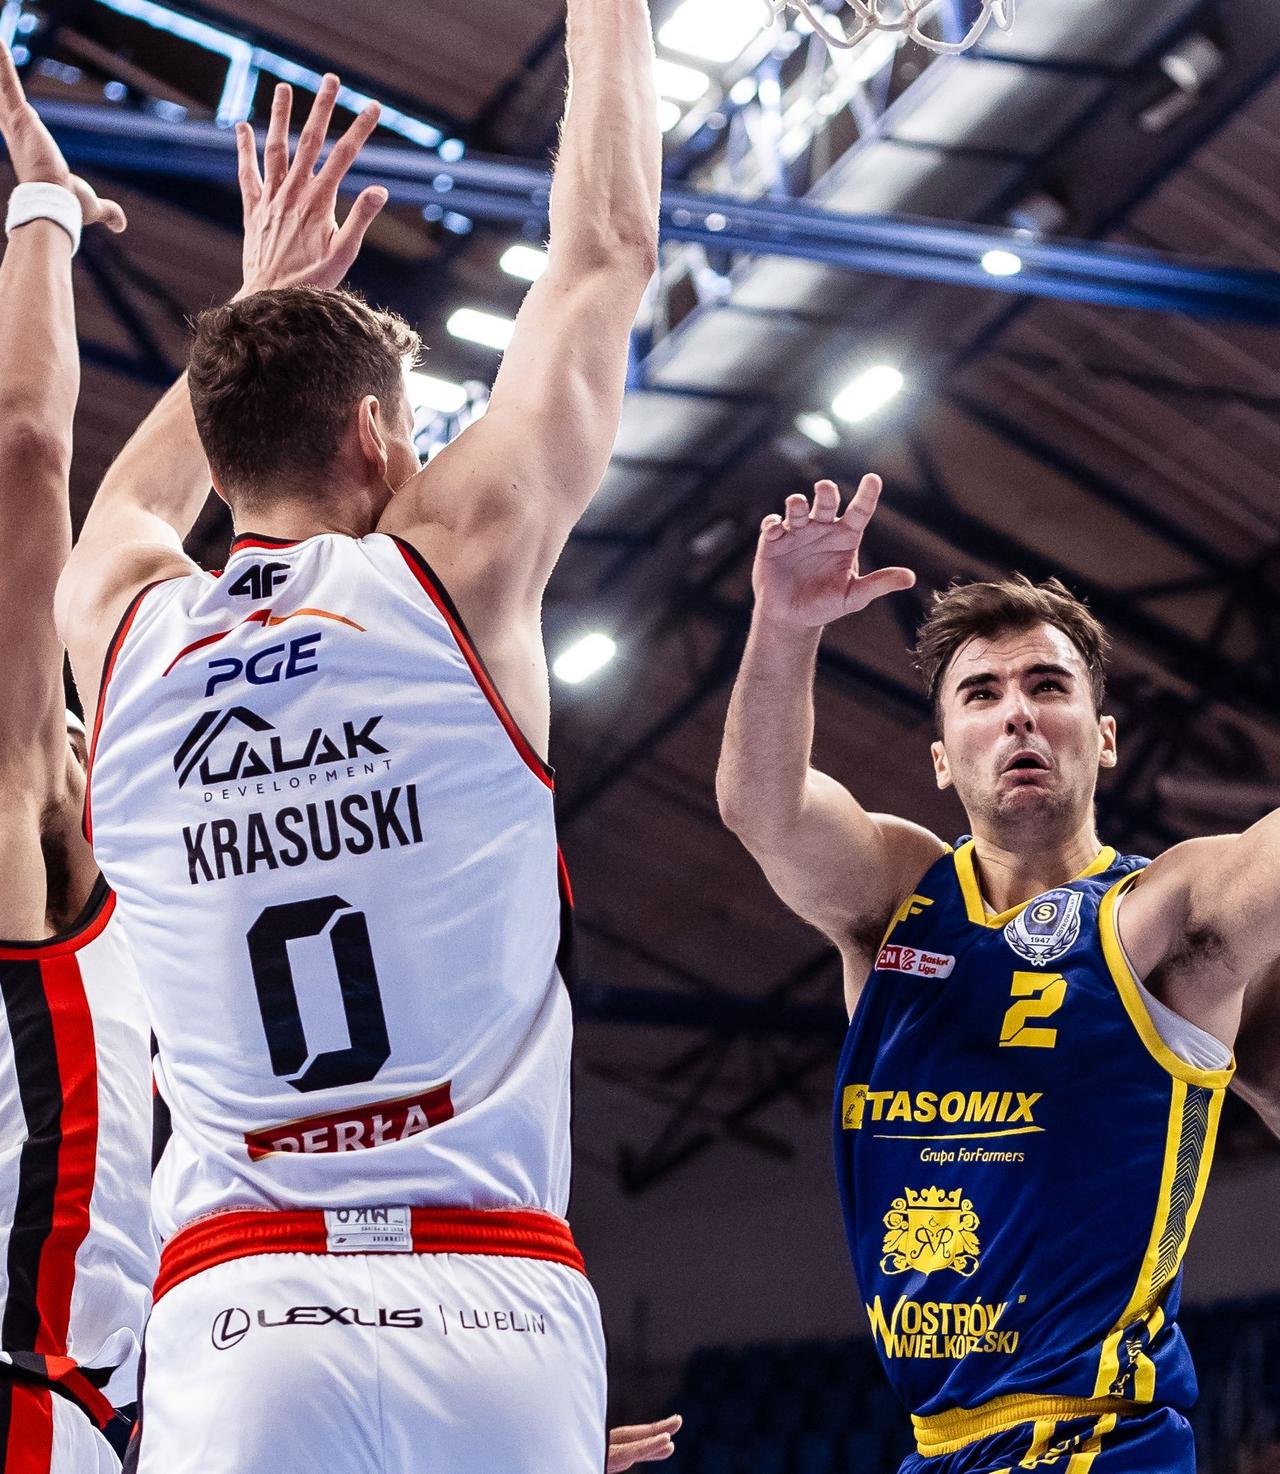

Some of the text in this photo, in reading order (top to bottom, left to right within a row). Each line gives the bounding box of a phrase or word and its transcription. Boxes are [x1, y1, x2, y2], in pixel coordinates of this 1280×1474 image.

[228, 562, 291, 600] 4F
[204, 632, 322, 698] PGE
[204, 759, 392, 803] DEVELOPMENT
[182, 784, 424, 885] KRASUSKI
[1030, 936, 1051, 944] 1947
[918, 963, 937, 975] Liga
[246, 895, 391, 1093] 0
[999, 971, 1068, 1048] 2
[866, 1091, 1044, 1123] TASOMIX
[920, 1146, 1025, 1167] Grupa ForFarmers
[257, 1305, 547, 1335] LEXUS LUBLIN
